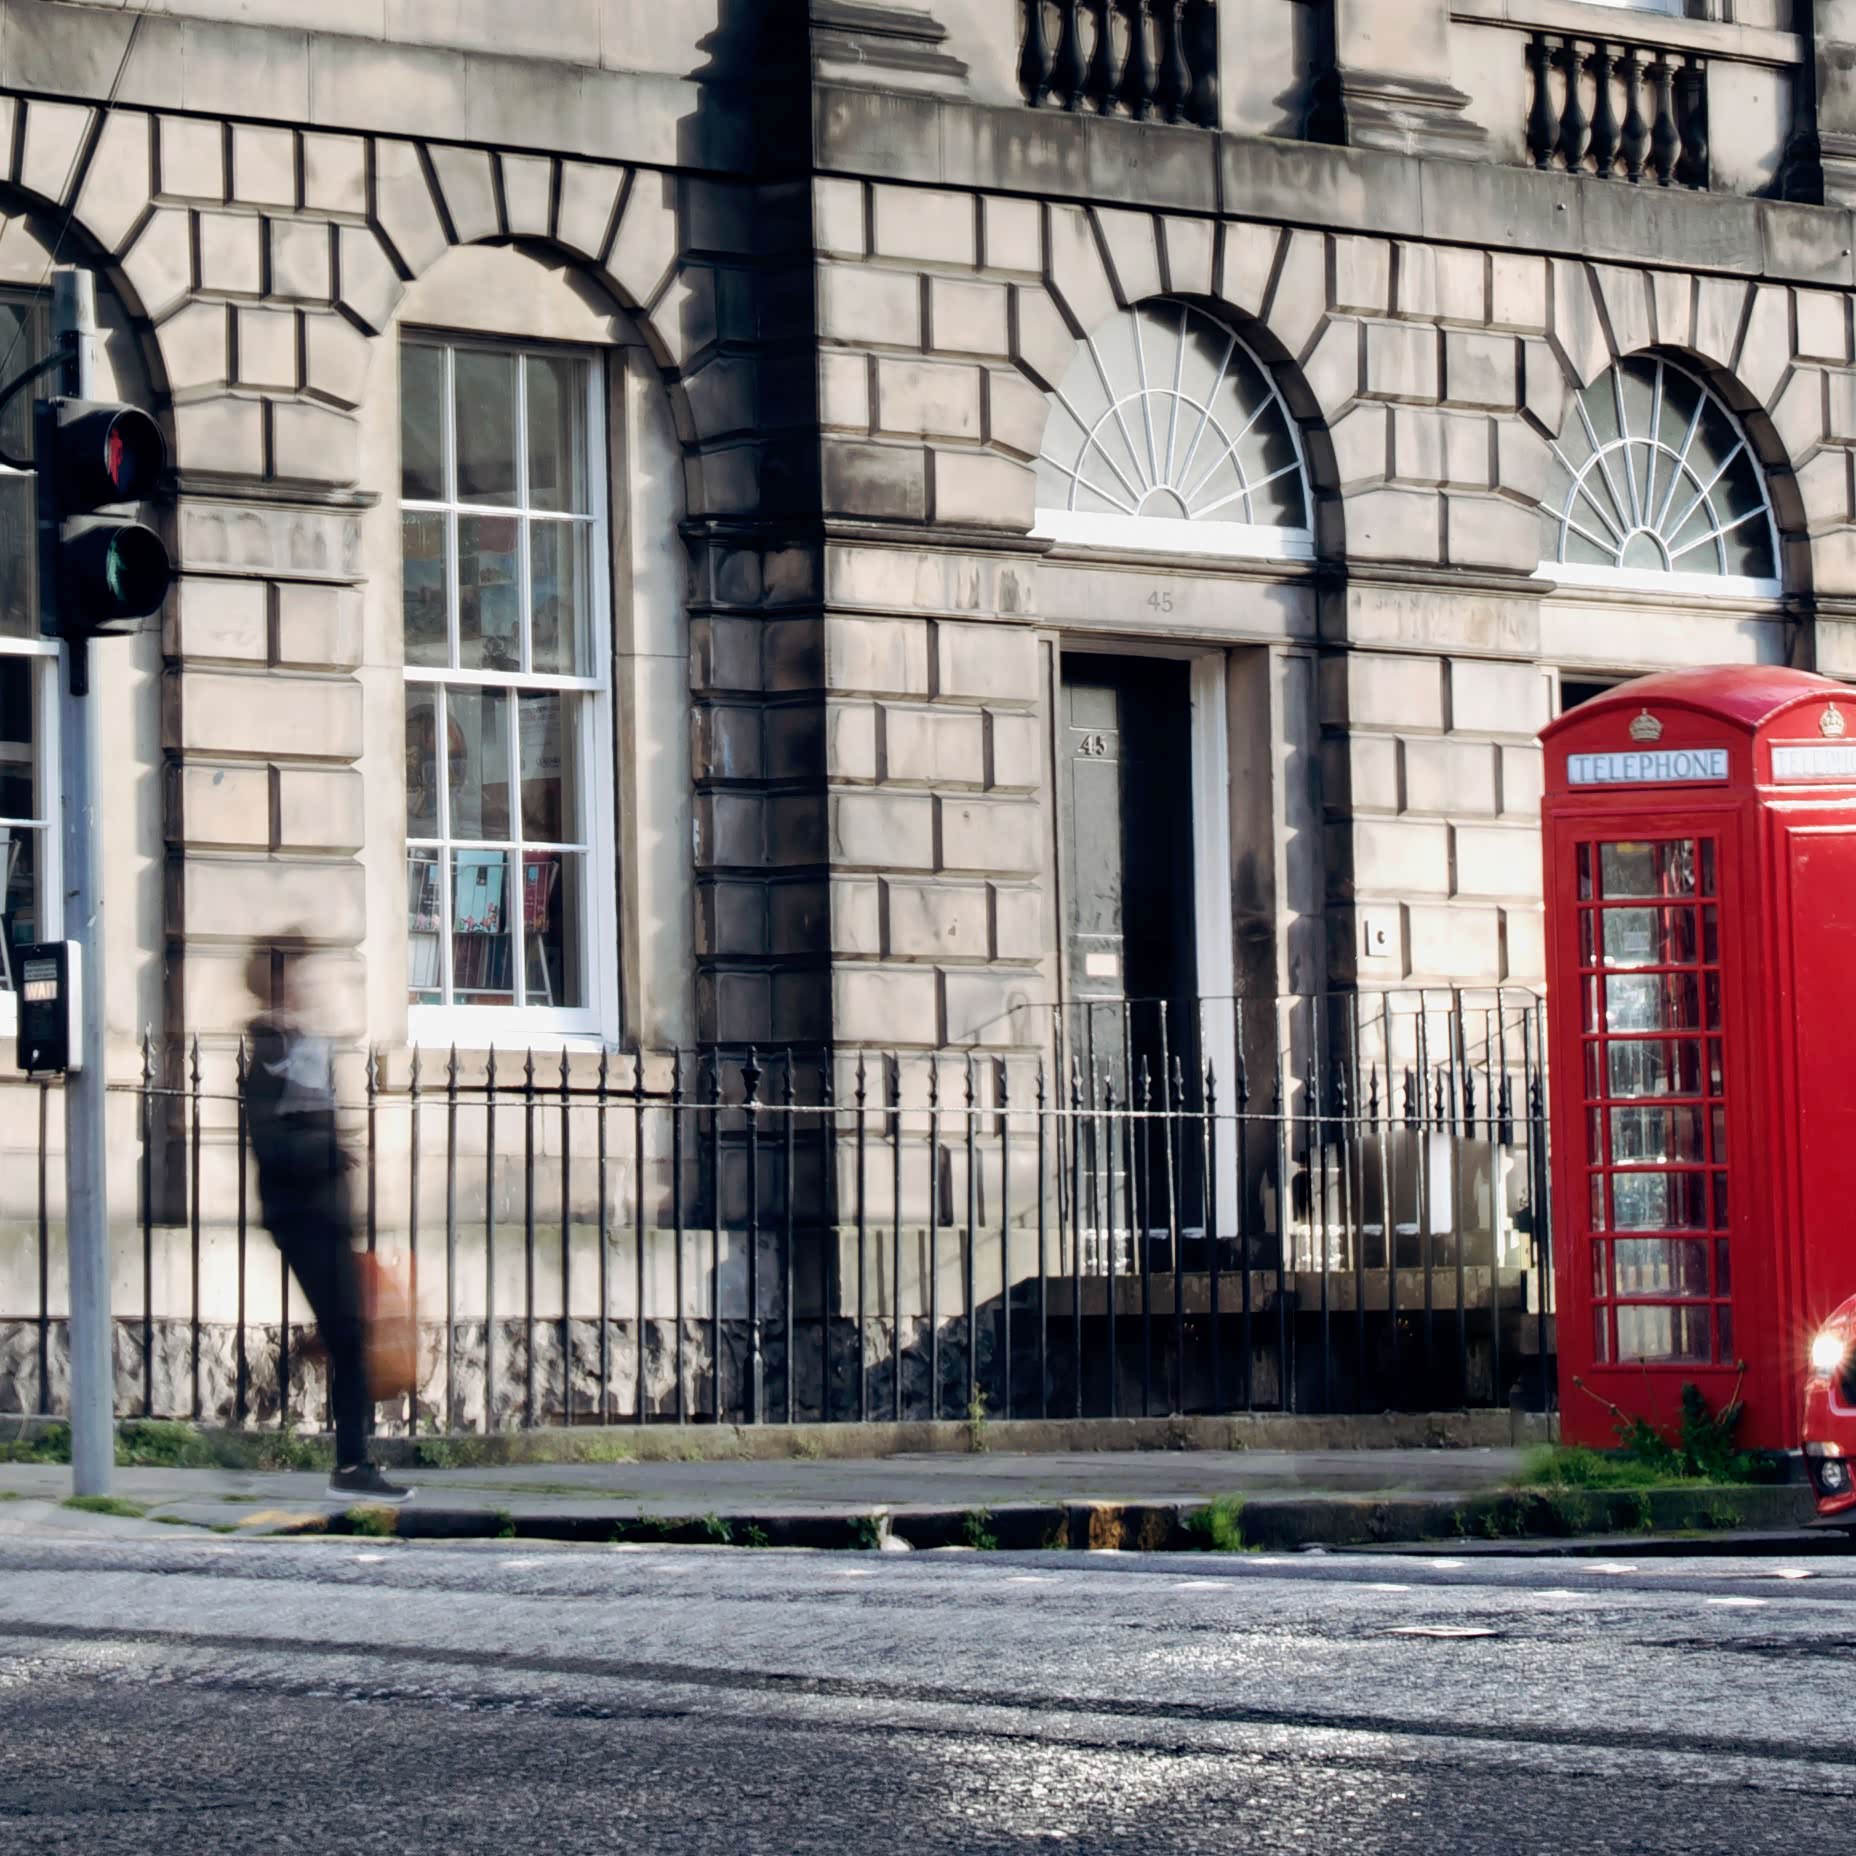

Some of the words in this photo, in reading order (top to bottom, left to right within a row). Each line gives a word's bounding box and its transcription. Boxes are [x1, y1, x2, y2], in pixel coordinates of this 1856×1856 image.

[1146, 590, 1174, 613] 45
[1078, 735, 1107, 756] 45
[1575, 750, 1725, 781] TELEPHONE
